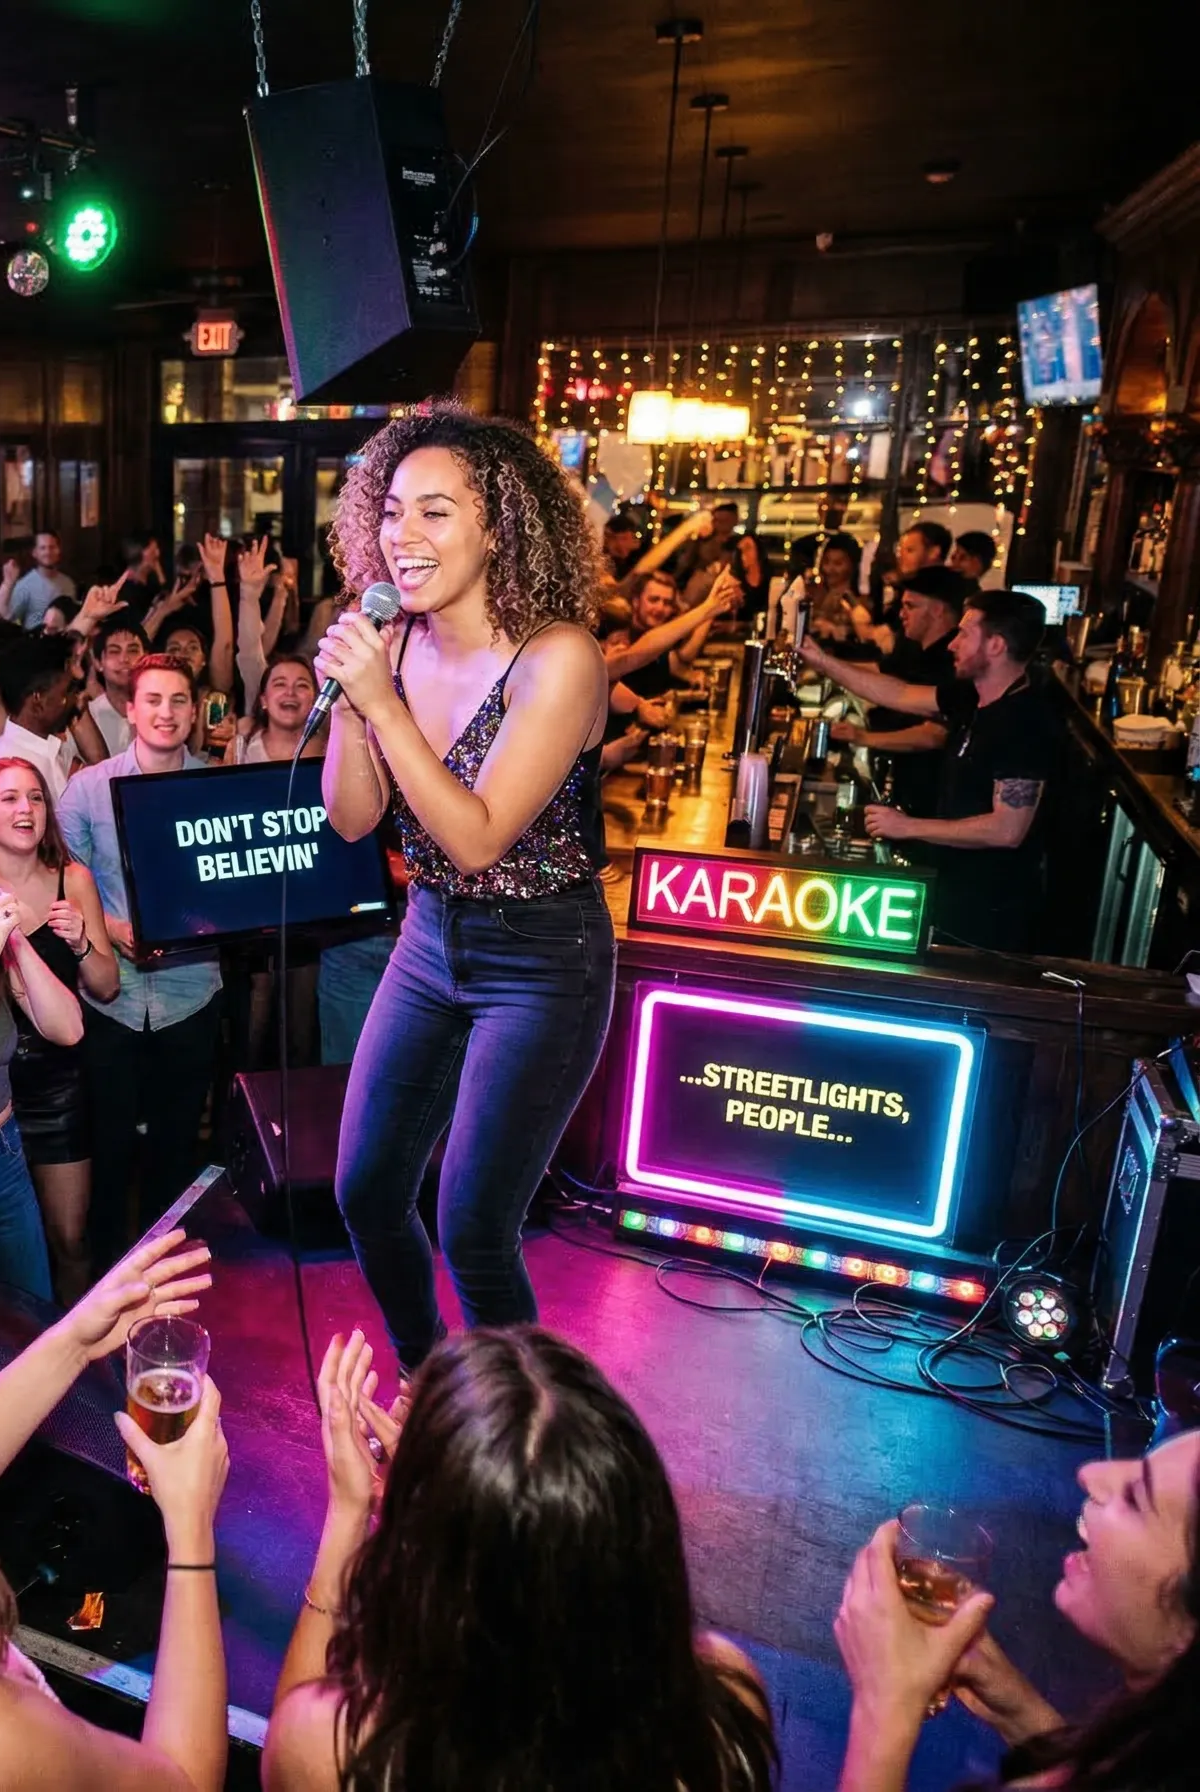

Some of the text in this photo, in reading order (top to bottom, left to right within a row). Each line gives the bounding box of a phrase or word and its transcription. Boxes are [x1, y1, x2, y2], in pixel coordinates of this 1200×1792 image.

[197, 322, 232, 351] EXIT
[175, 806, 328, 848] DON'T STOP
[196, 842, 319, 882] BELIEVIN'
[646, 861, 917, 941] KARAOKE
[679, 1062, 911, 1124] ...STREETLIGHTS,
[725, 1098, 853, 1144] PEOPLE...
